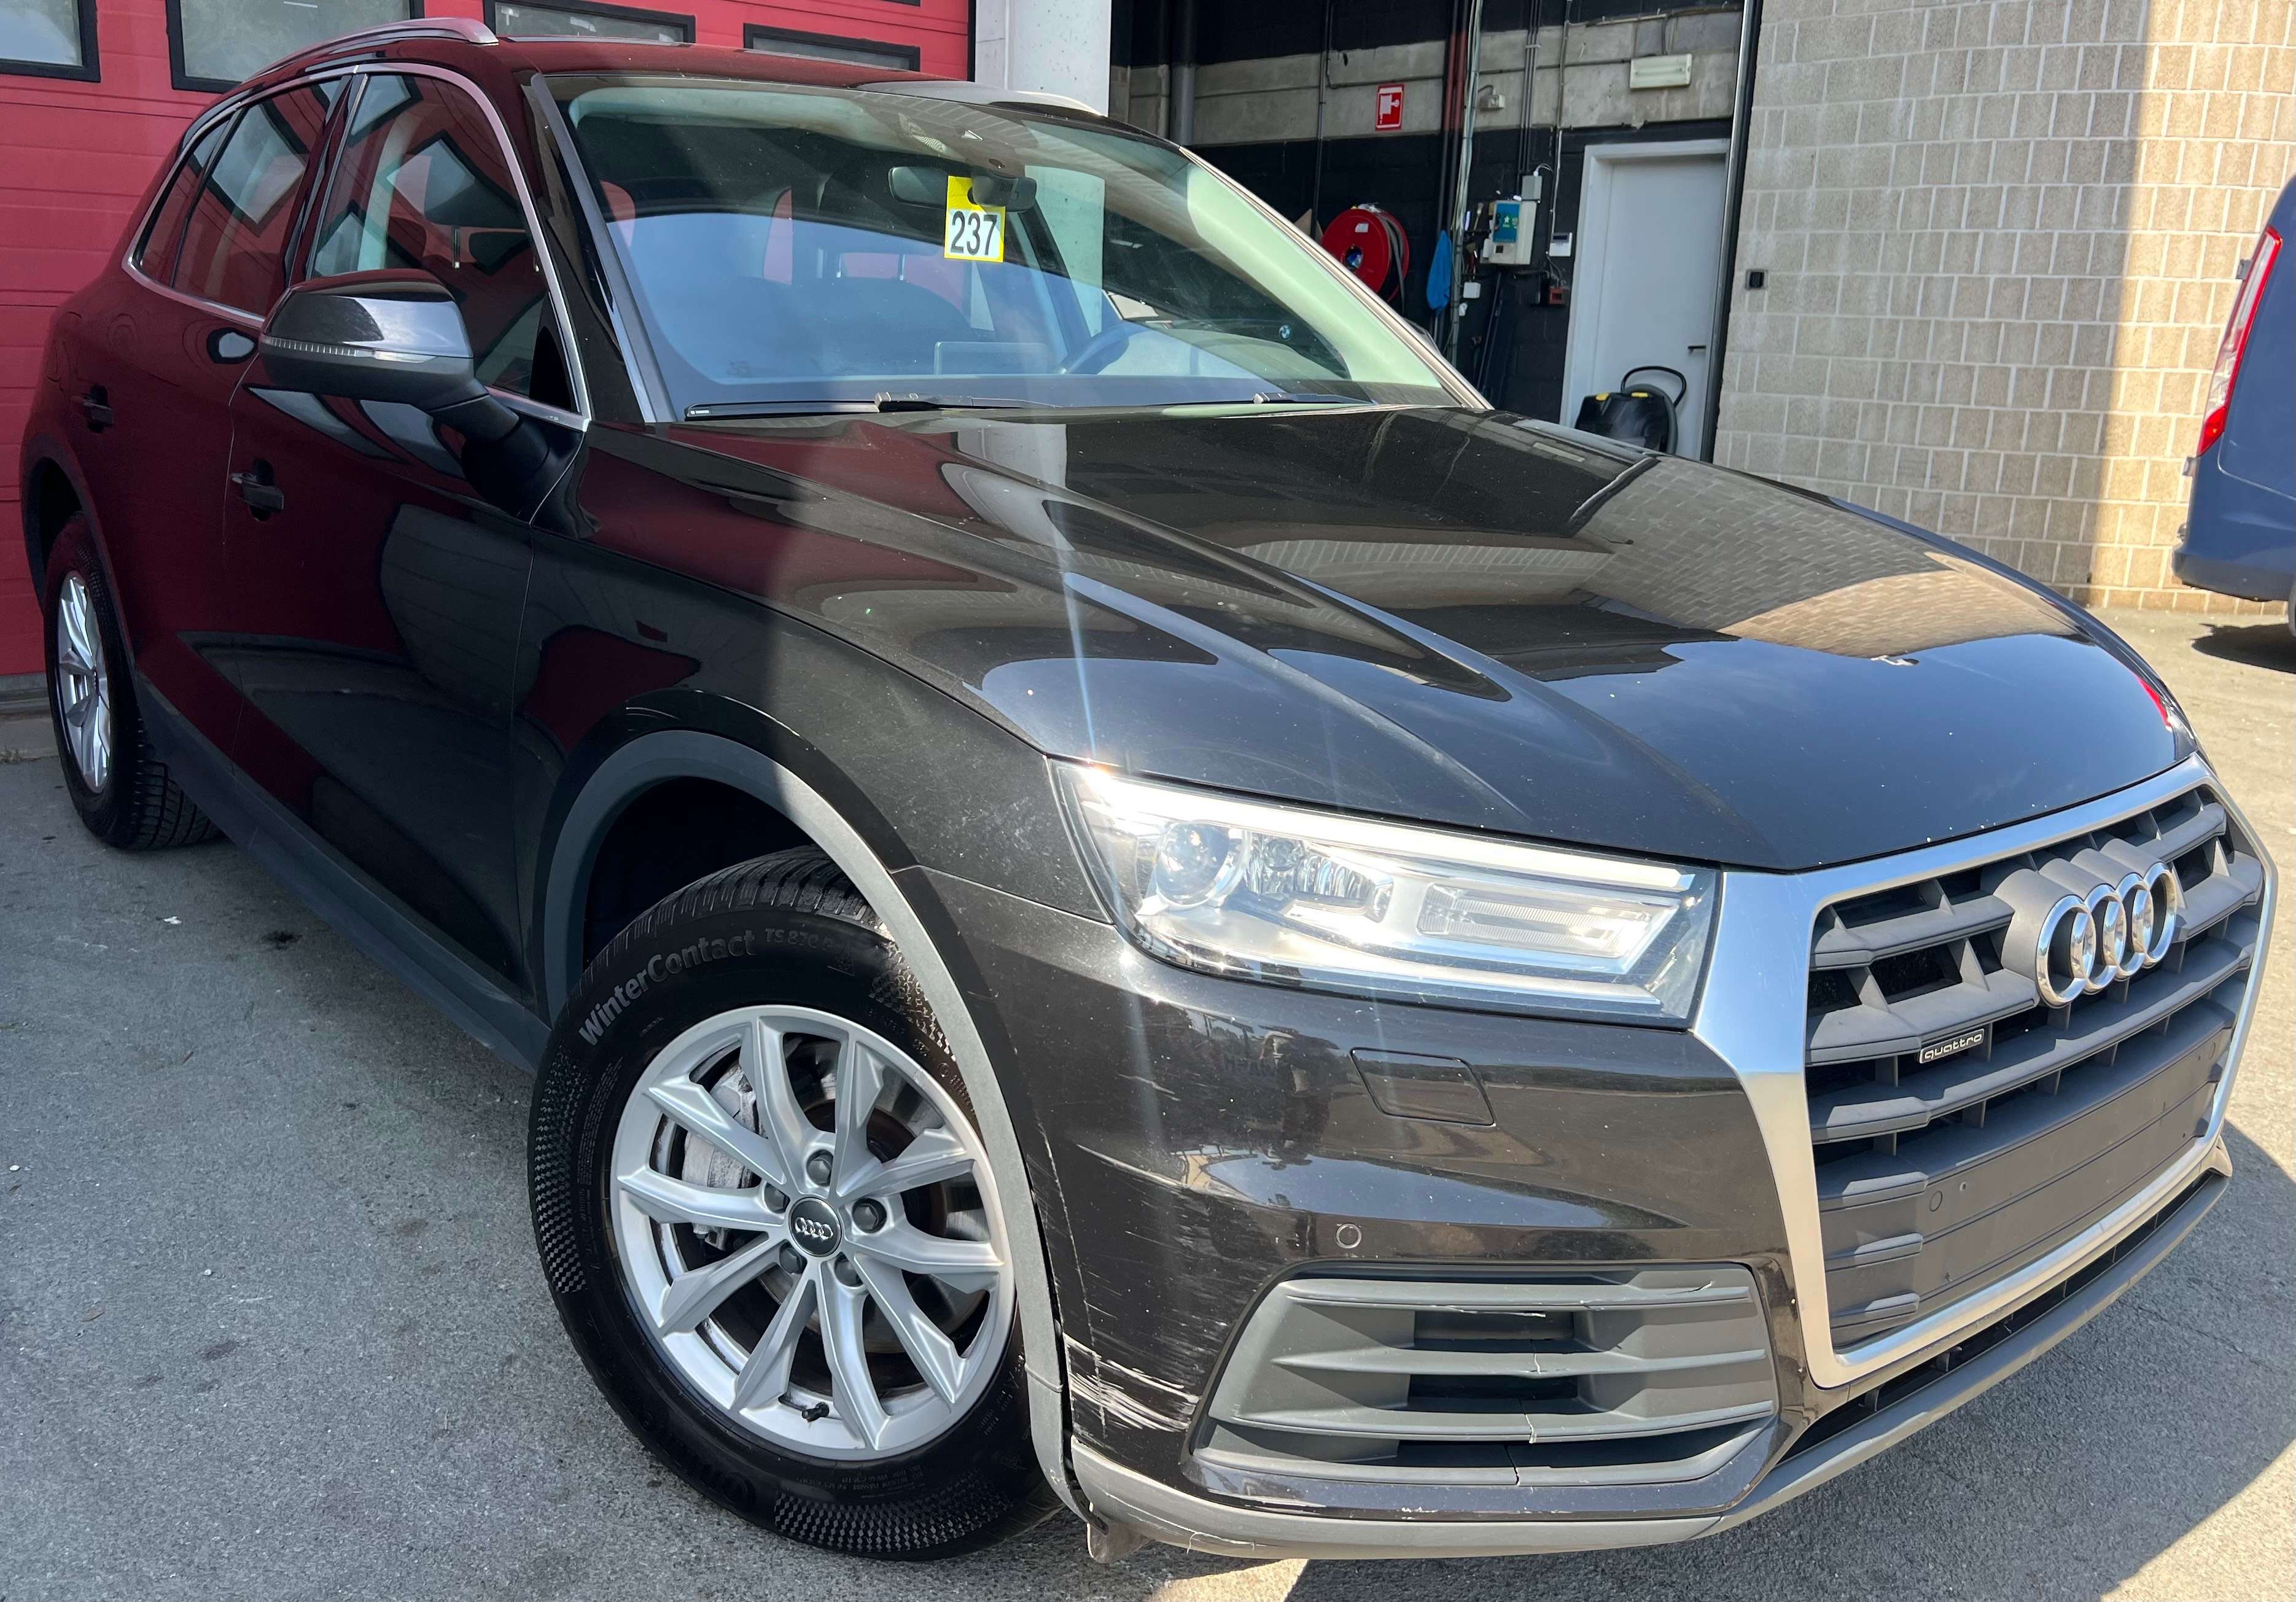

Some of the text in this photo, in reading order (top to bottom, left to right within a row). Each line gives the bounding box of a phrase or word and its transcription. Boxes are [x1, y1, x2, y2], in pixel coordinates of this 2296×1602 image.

[951, 211, 998, 256] 237
[578, 929, 757, 1046] WinterContact
[1924, 1033, 1982, 1060] quattro
